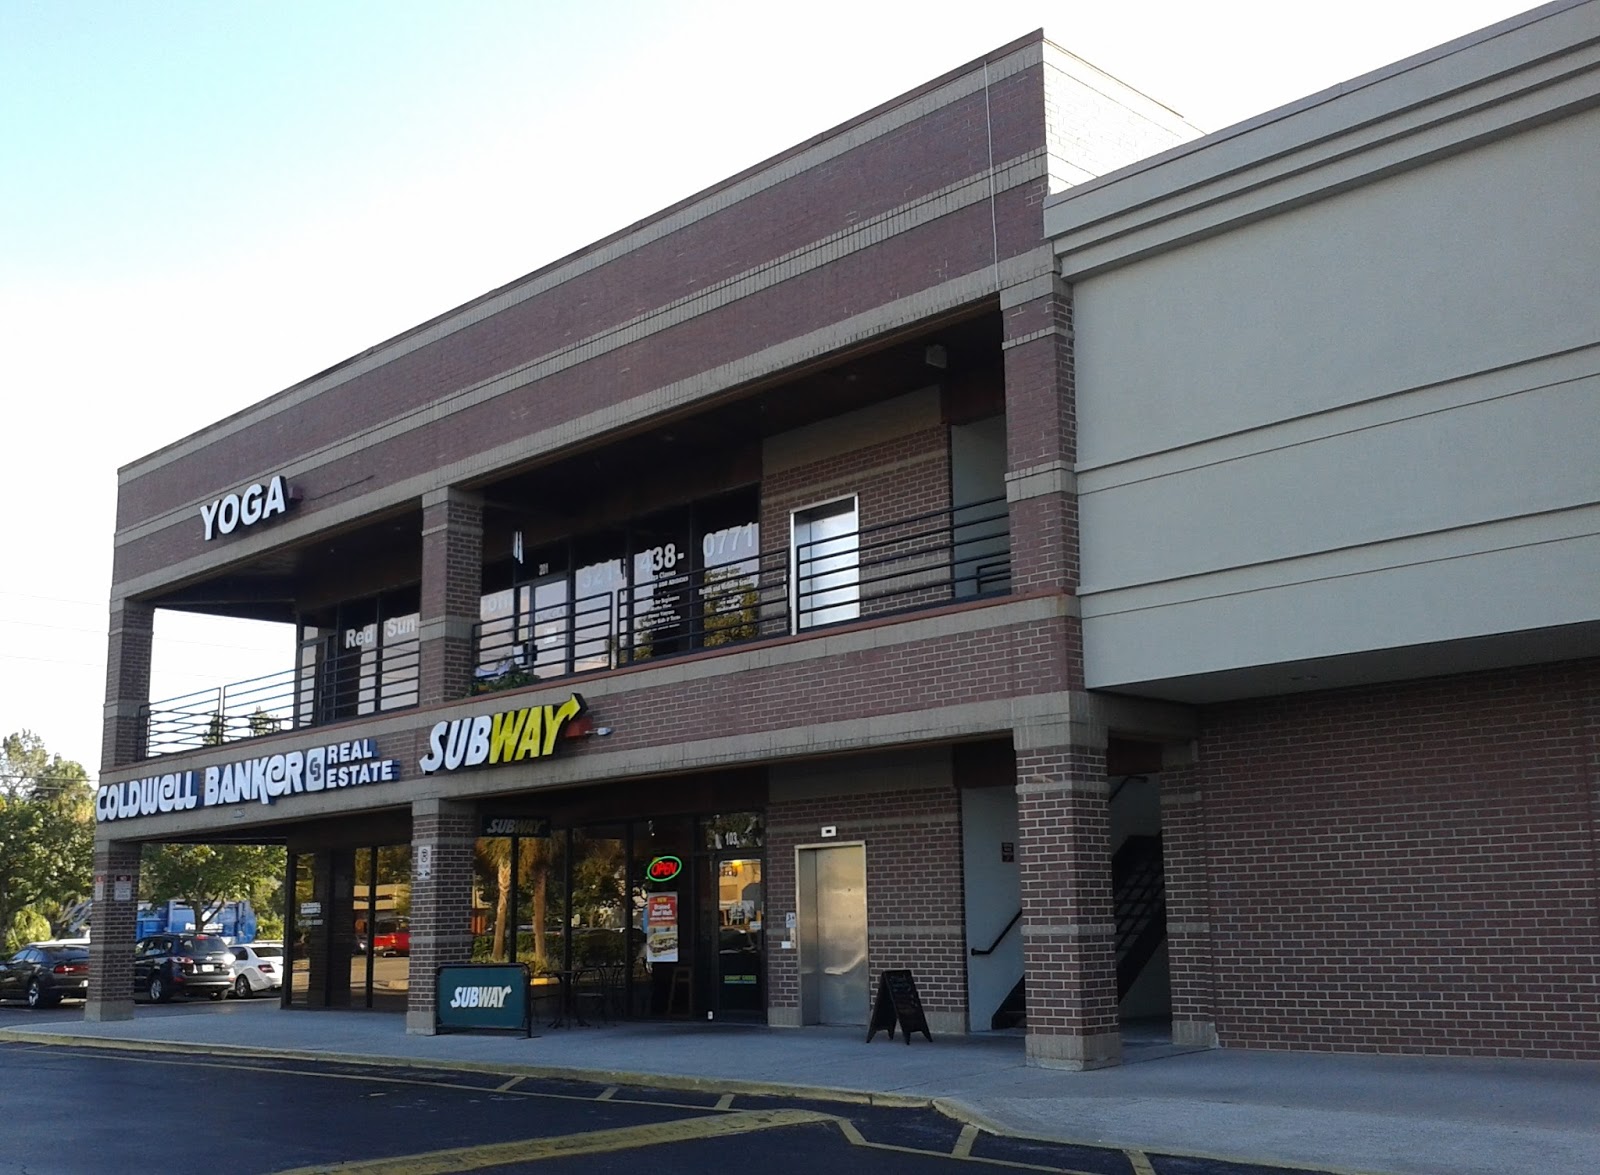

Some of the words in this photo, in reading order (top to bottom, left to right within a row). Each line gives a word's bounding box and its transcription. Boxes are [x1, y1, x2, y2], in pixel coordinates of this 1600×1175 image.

[201, 475, 286, 541] YOGA
[703, 522, 753, 557] 0771
[345, 623, 373, 649] Red
[387, 617, 415, 637] Sun
[419, 693, 582, 775] SUBWAY
[327, 739, 373, 765] REAL
[326, 760, 393, 788] ESTATE
[486, 818, 546, 835] SUBWAY
[651, 860, 677, 877] OPEN
[451, 985, 512, 1008] SUBWAY
